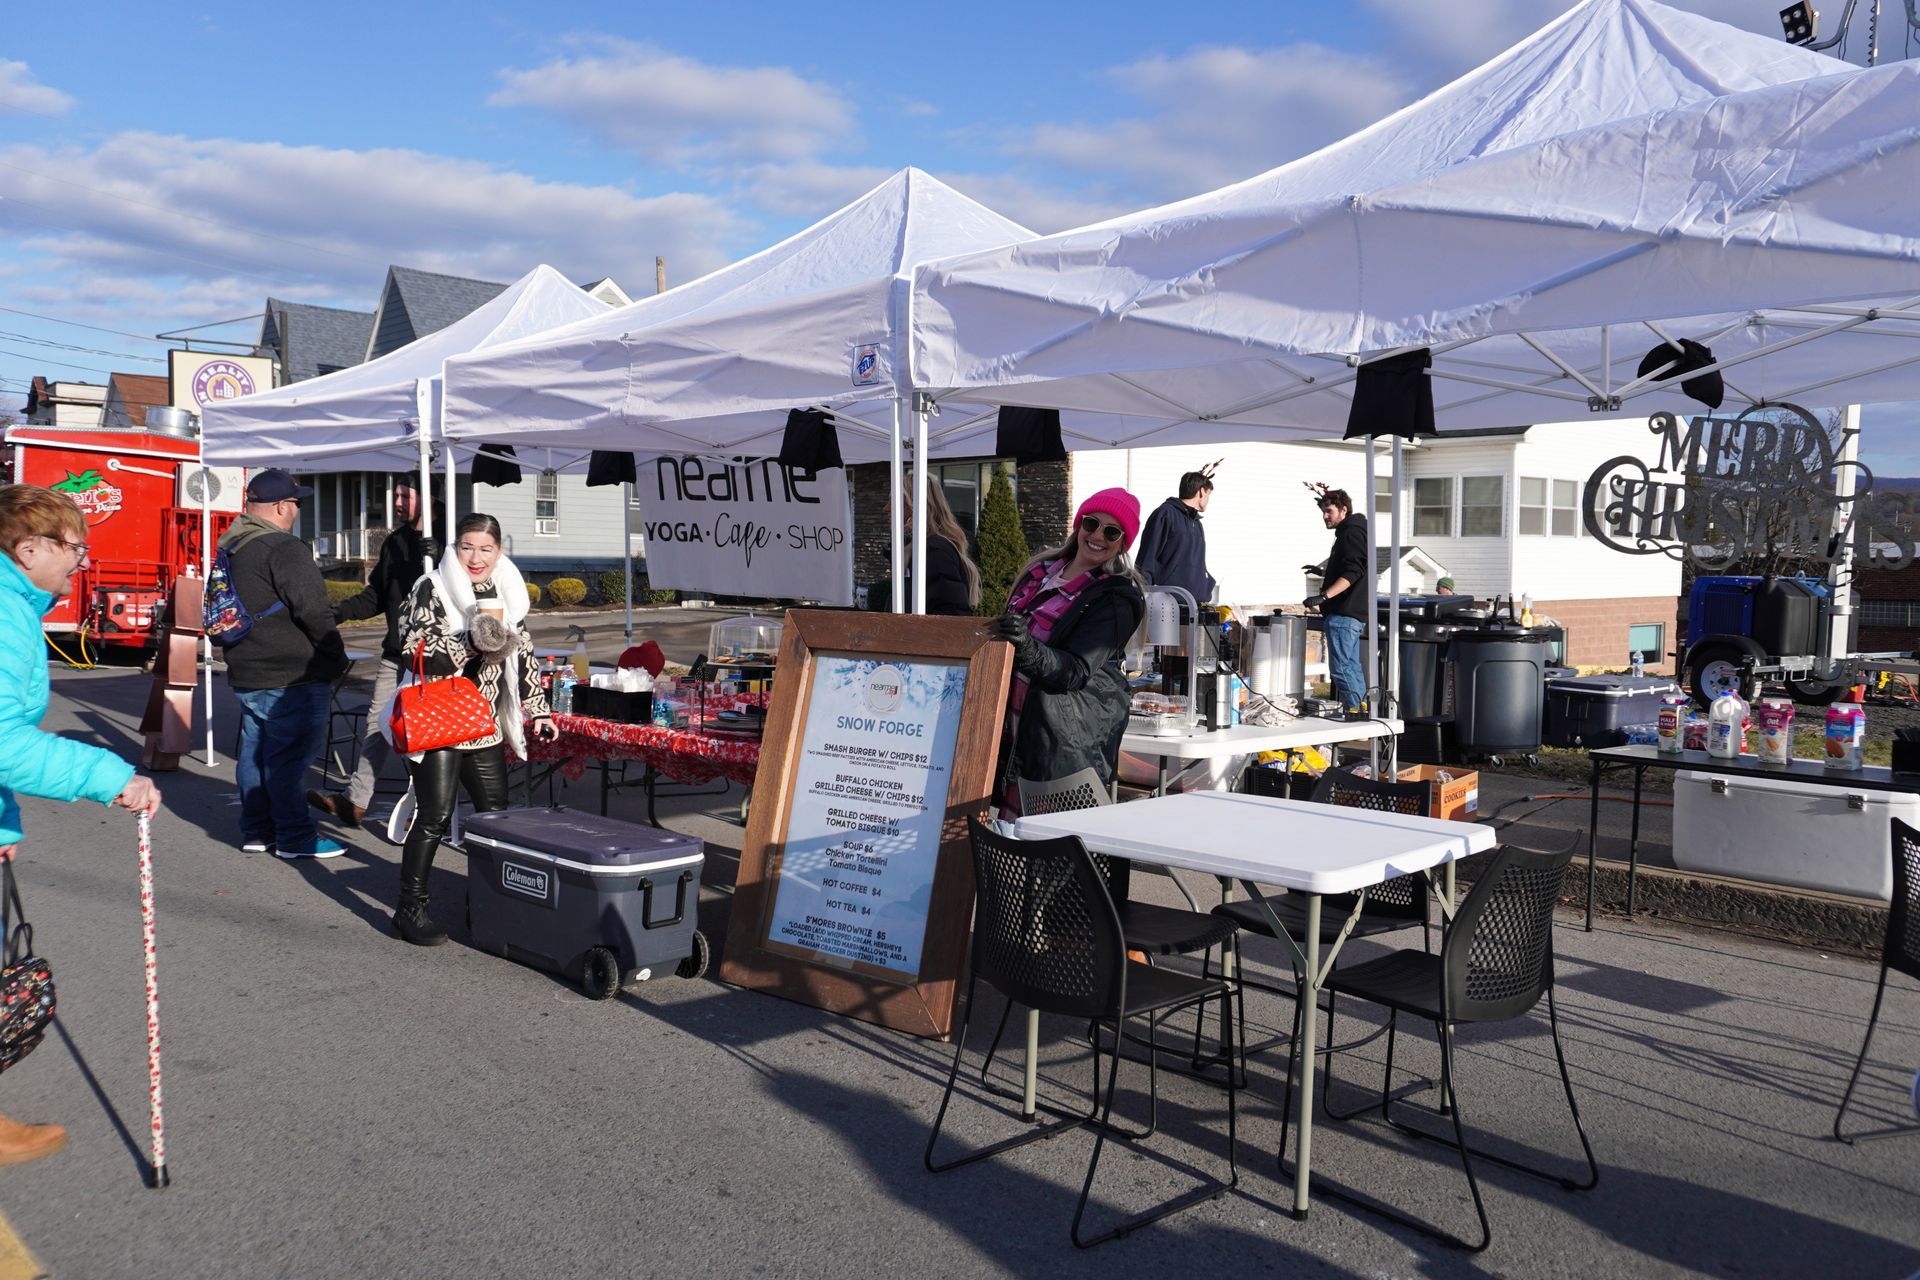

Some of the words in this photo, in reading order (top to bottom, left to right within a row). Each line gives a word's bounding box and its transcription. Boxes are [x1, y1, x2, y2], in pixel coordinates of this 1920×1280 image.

[200, 364, 250, 386] REALTY
[1648, 402, 1861, 482] MERRY
[1583, 455, 1916, 571] CHRISTMAS
[645, 522, 704, 543] YOGA
[714, 512, 772, 569] Cafe
[788, 524, 844, 552] SHOP
[837, 716, 876, 732] SNOW
[878, 720, 924, 738] FORGE
[824, 743, 848, 753] SMASH
[849, 746, 877, 758] BURGER
[878, 749, 889, 759] W/
[890, 751, 914, 762] CHIPS
[915, 754, 928, 764] $12
[835, 774, 868, 786] BUFFALO
[868, 779, 904, 791] CHICKEN
[815, 781, 845, 793] GRILLED
[846, 785, 873, 797] CHEESE
[874, 789, 885, 799] W/
[886, 791, 910, 802] CHIPS
[911, 794, 924, 805] $12
[1444, 785, 1467, 804] COOKIES
[904, 803, 928, 811] PERFECTION
[826, 817, 857, 830] TOMATO
[858, 824, 887, 835] BISQUE
[887, 827, 900, 837] $10
[827, 808, 858, 820] GRILLED
[859, 813, 887, 824] CHEESE
[889, 817, 900, 827] W/
[843, 840, 863, 851] SOUP
[864, 844, 874, 853] $6
[825, 848, 855, 860] Chicken
[856, 853, 888, 867] Tortellini
[506, 866, 536, 887] Coleman
[829, 859, 857, 871] Tomato
[858, 865, 882, 876] Bisque
[822, 878, 839, 888] HOT
[840, 881, 868, 894] COFFEE
[871, 887, 882, 897] $4
[826, 899, 842, 910] HOT
[843, 902, 857, 913] TEA
[861, 906, 871, 916] $4
[806, 915, 836, 929] S'MORES
[837, 922, 872, 938] BROWNIE
[876, 930, 887, 940] $5
[827, 930, 852, 941] WHIPPED
[797, 938, 820, 949] GRAHAM
[820, 944, 846, 955] CRACKER
[816, 935, 841, 946] TOASTED
[890, 952, 903, 961] AND
